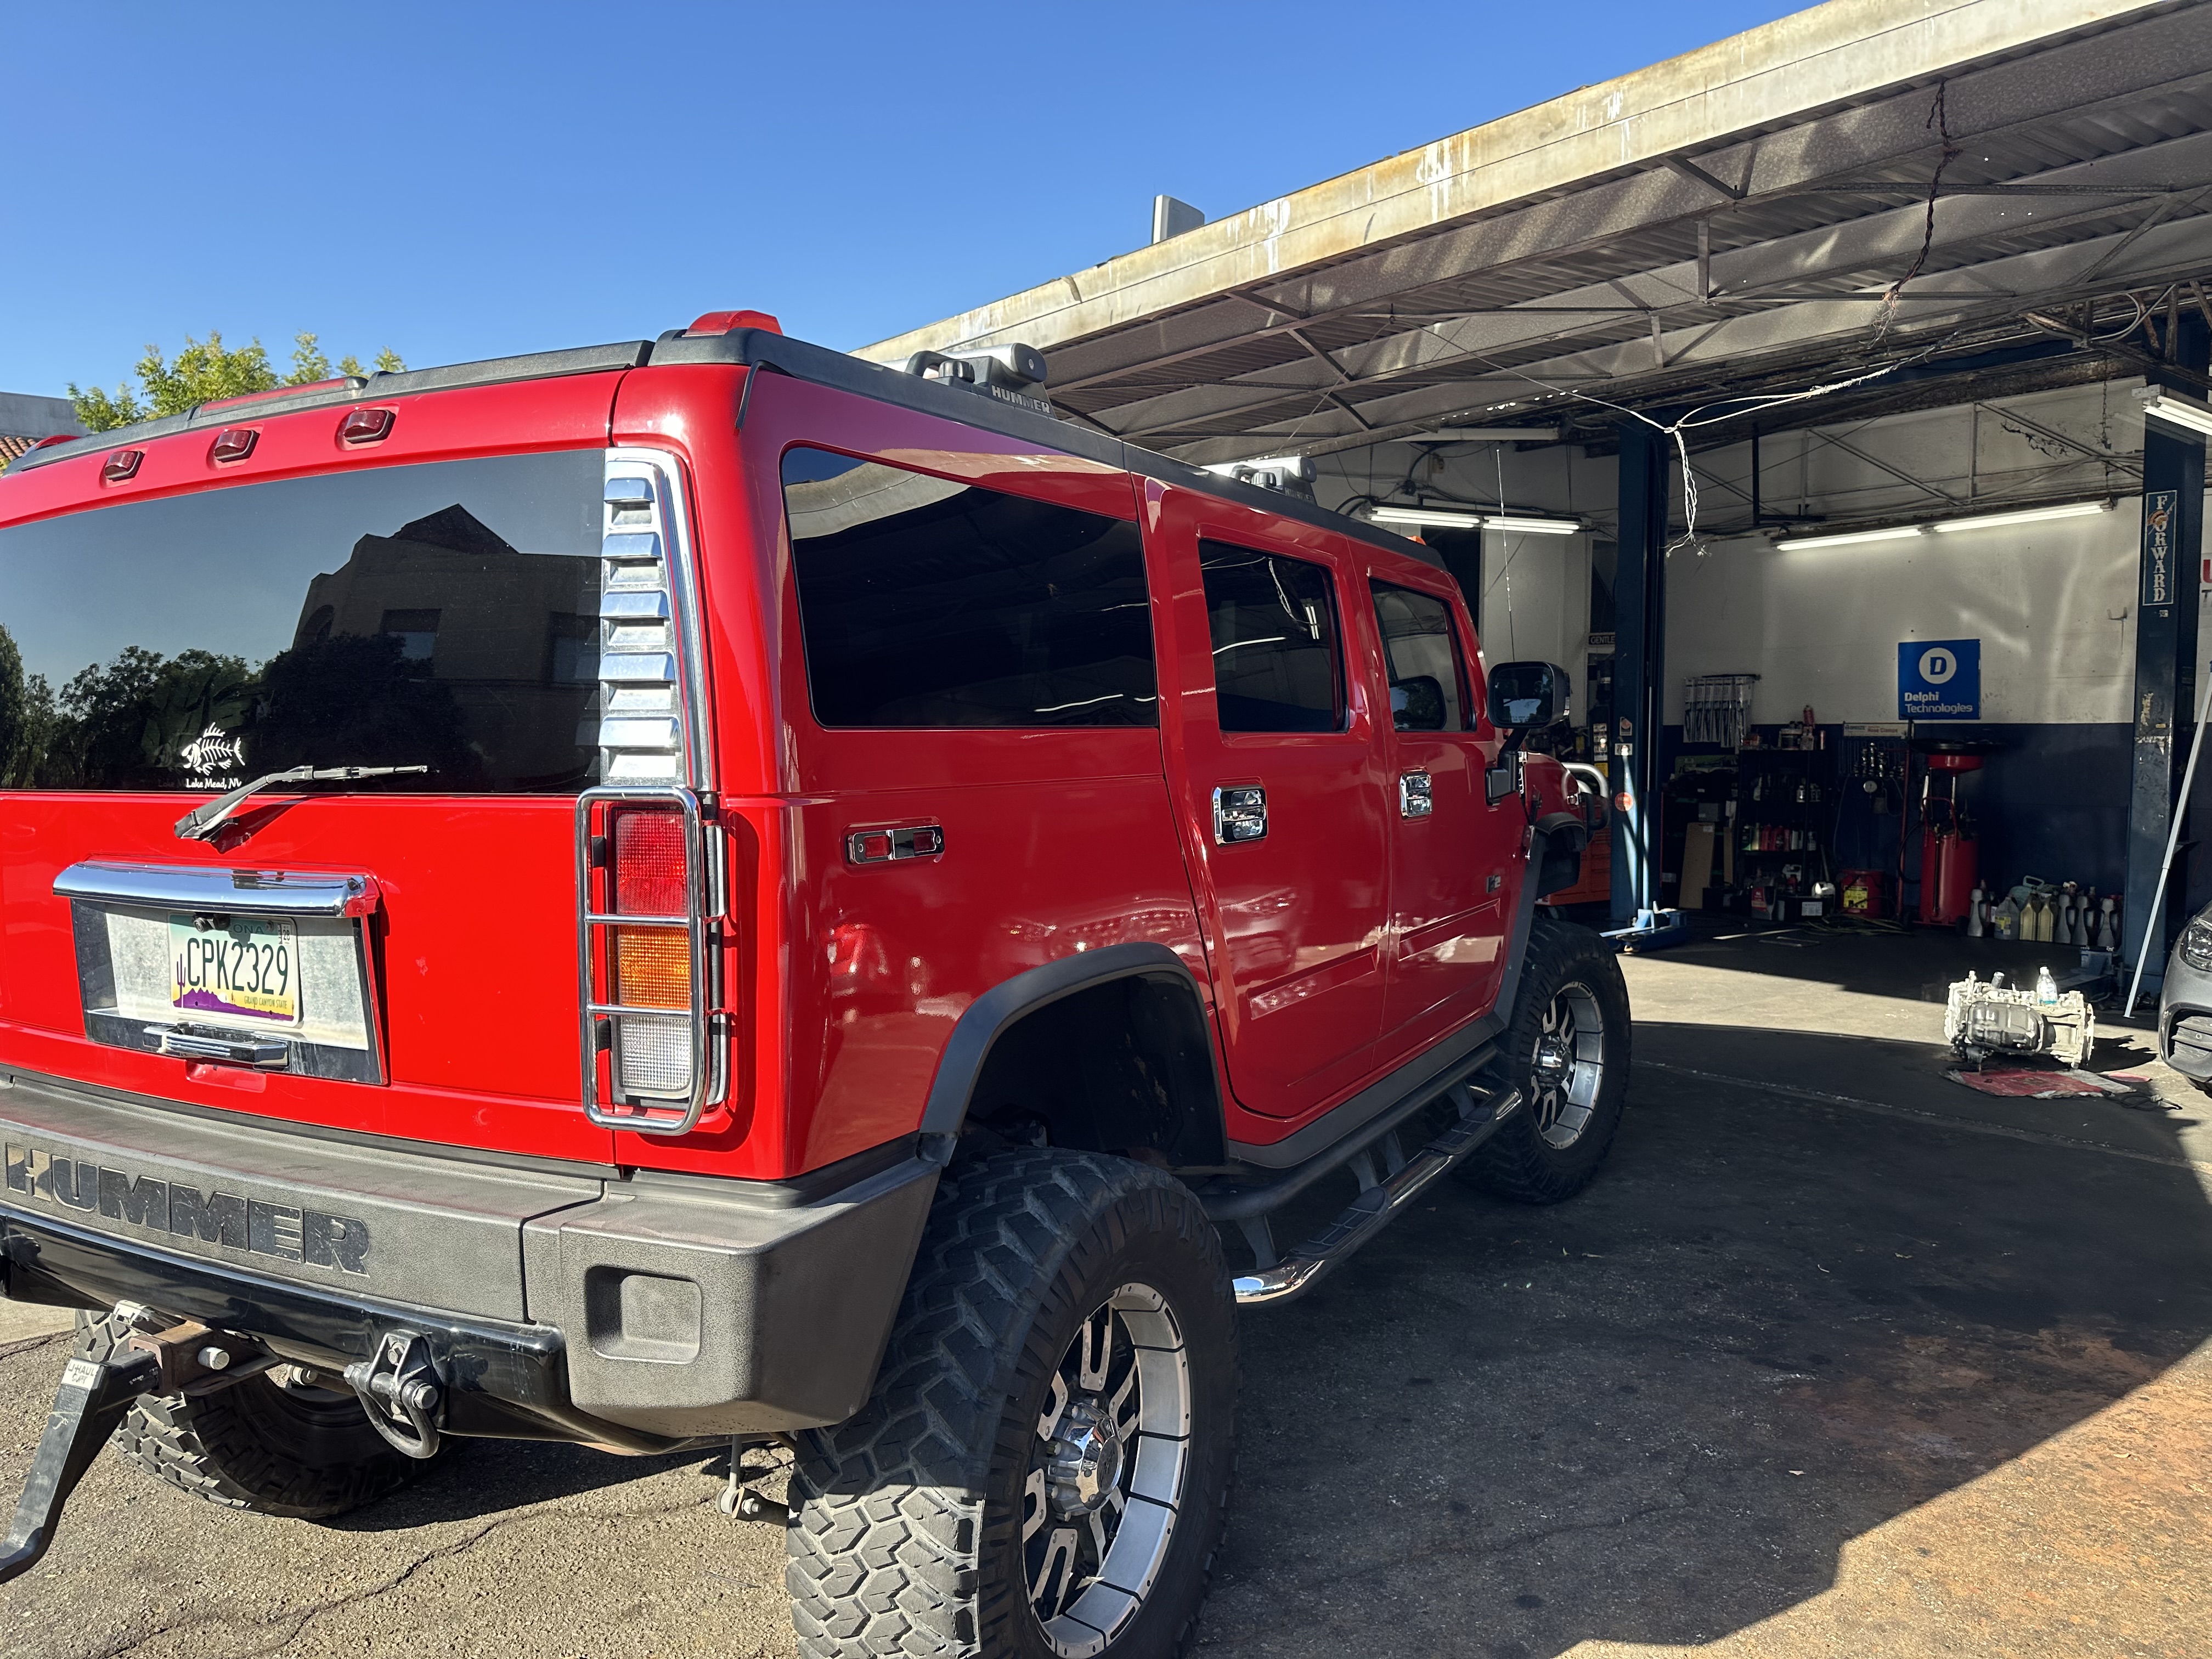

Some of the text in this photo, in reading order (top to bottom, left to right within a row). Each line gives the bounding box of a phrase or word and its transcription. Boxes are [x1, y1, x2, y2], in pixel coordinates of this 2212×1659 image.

[991, 385, 1051, 414] HUMMER
[2151, 495, 2168, 602] FORWARD
[1590, 636, 1615, 644] GENTLE
[1929, 656, 1948, 675] D
[1904, 691, 1939, 703] Delphi
[1905, 703, 1973, 714] Technologies
[185, 777, 204, 788] Lake
[204, 777, 227, 789] Mead,
[283, 929, 290, 941] 28
[187, 938, 289, 996] CPK2329
[244, 995, 287, 1009] GRAND CANYON STATE
[5, 1142, 370, 1278] HUMMER
